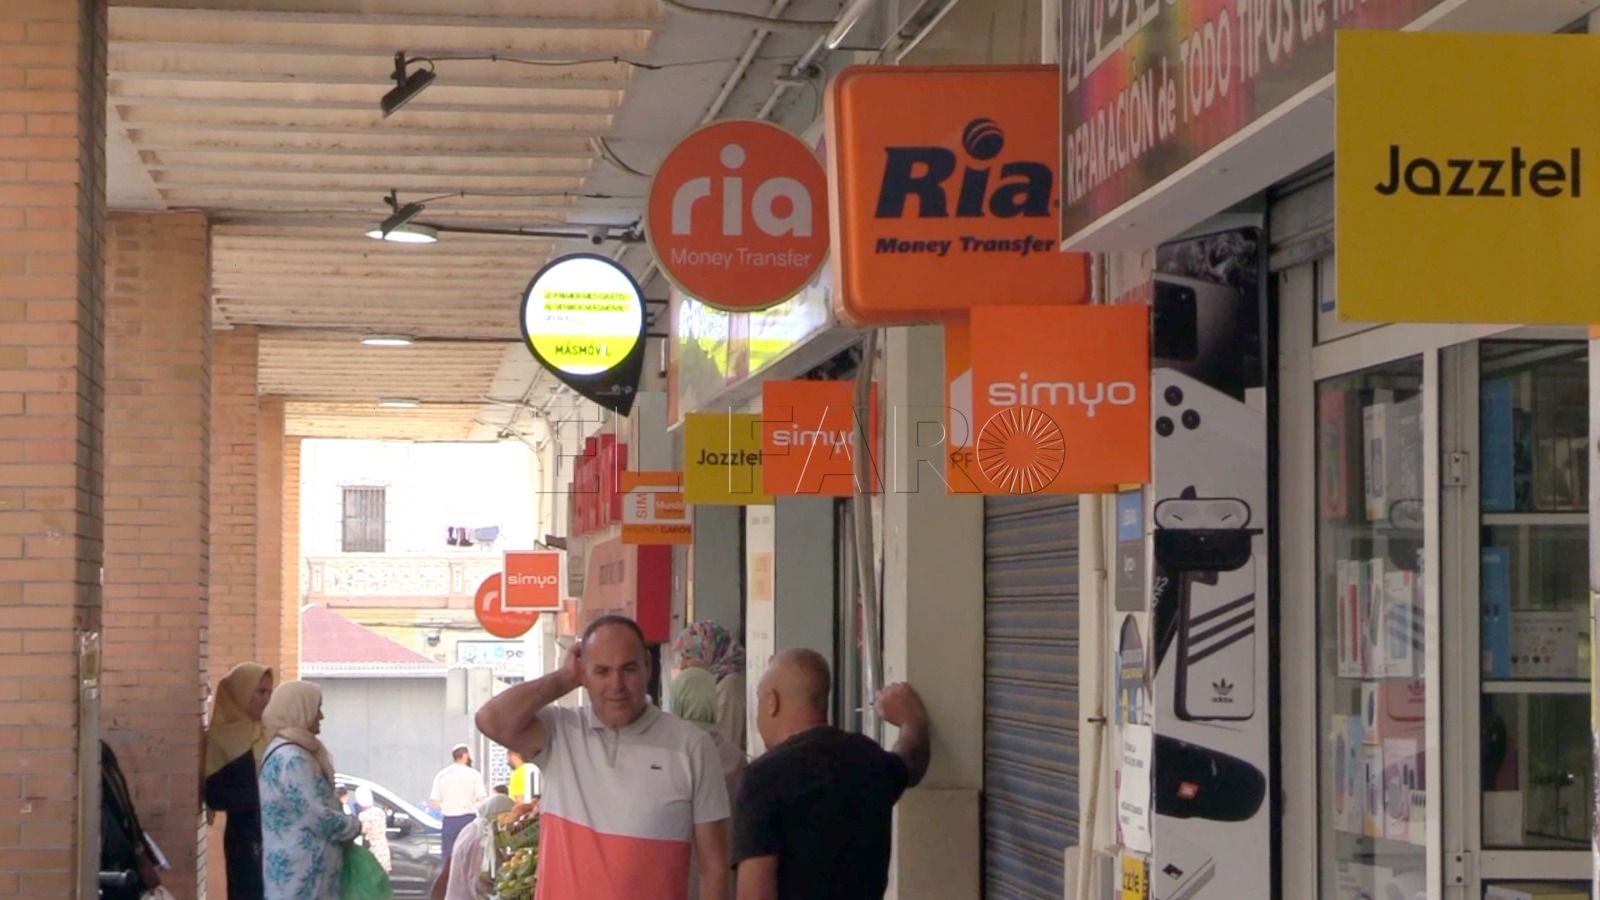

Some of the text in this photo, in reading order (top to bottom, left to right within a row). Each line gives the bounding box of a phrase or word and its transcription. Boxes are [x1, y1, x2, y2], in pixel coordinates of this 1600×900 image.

[1067, 60, 1154, 206] REPARACIÓN
[1158, 55, 1176, 141] de
[1180, 9, 1231, 123] TODO
[1236, 0, 1293, 82] TIPOS
[671, 143, 812, 236] ria
[875, 117, 1054, 218] Ria
[1375, 145, 1580, 198] Jazztel
[671, 248, 812, 269] Money Transfer
[875, 235, 1055, 257] Money Transfer
[988, 372, 1136, 417] simyo
[507, 571, 557, 588] simyo
